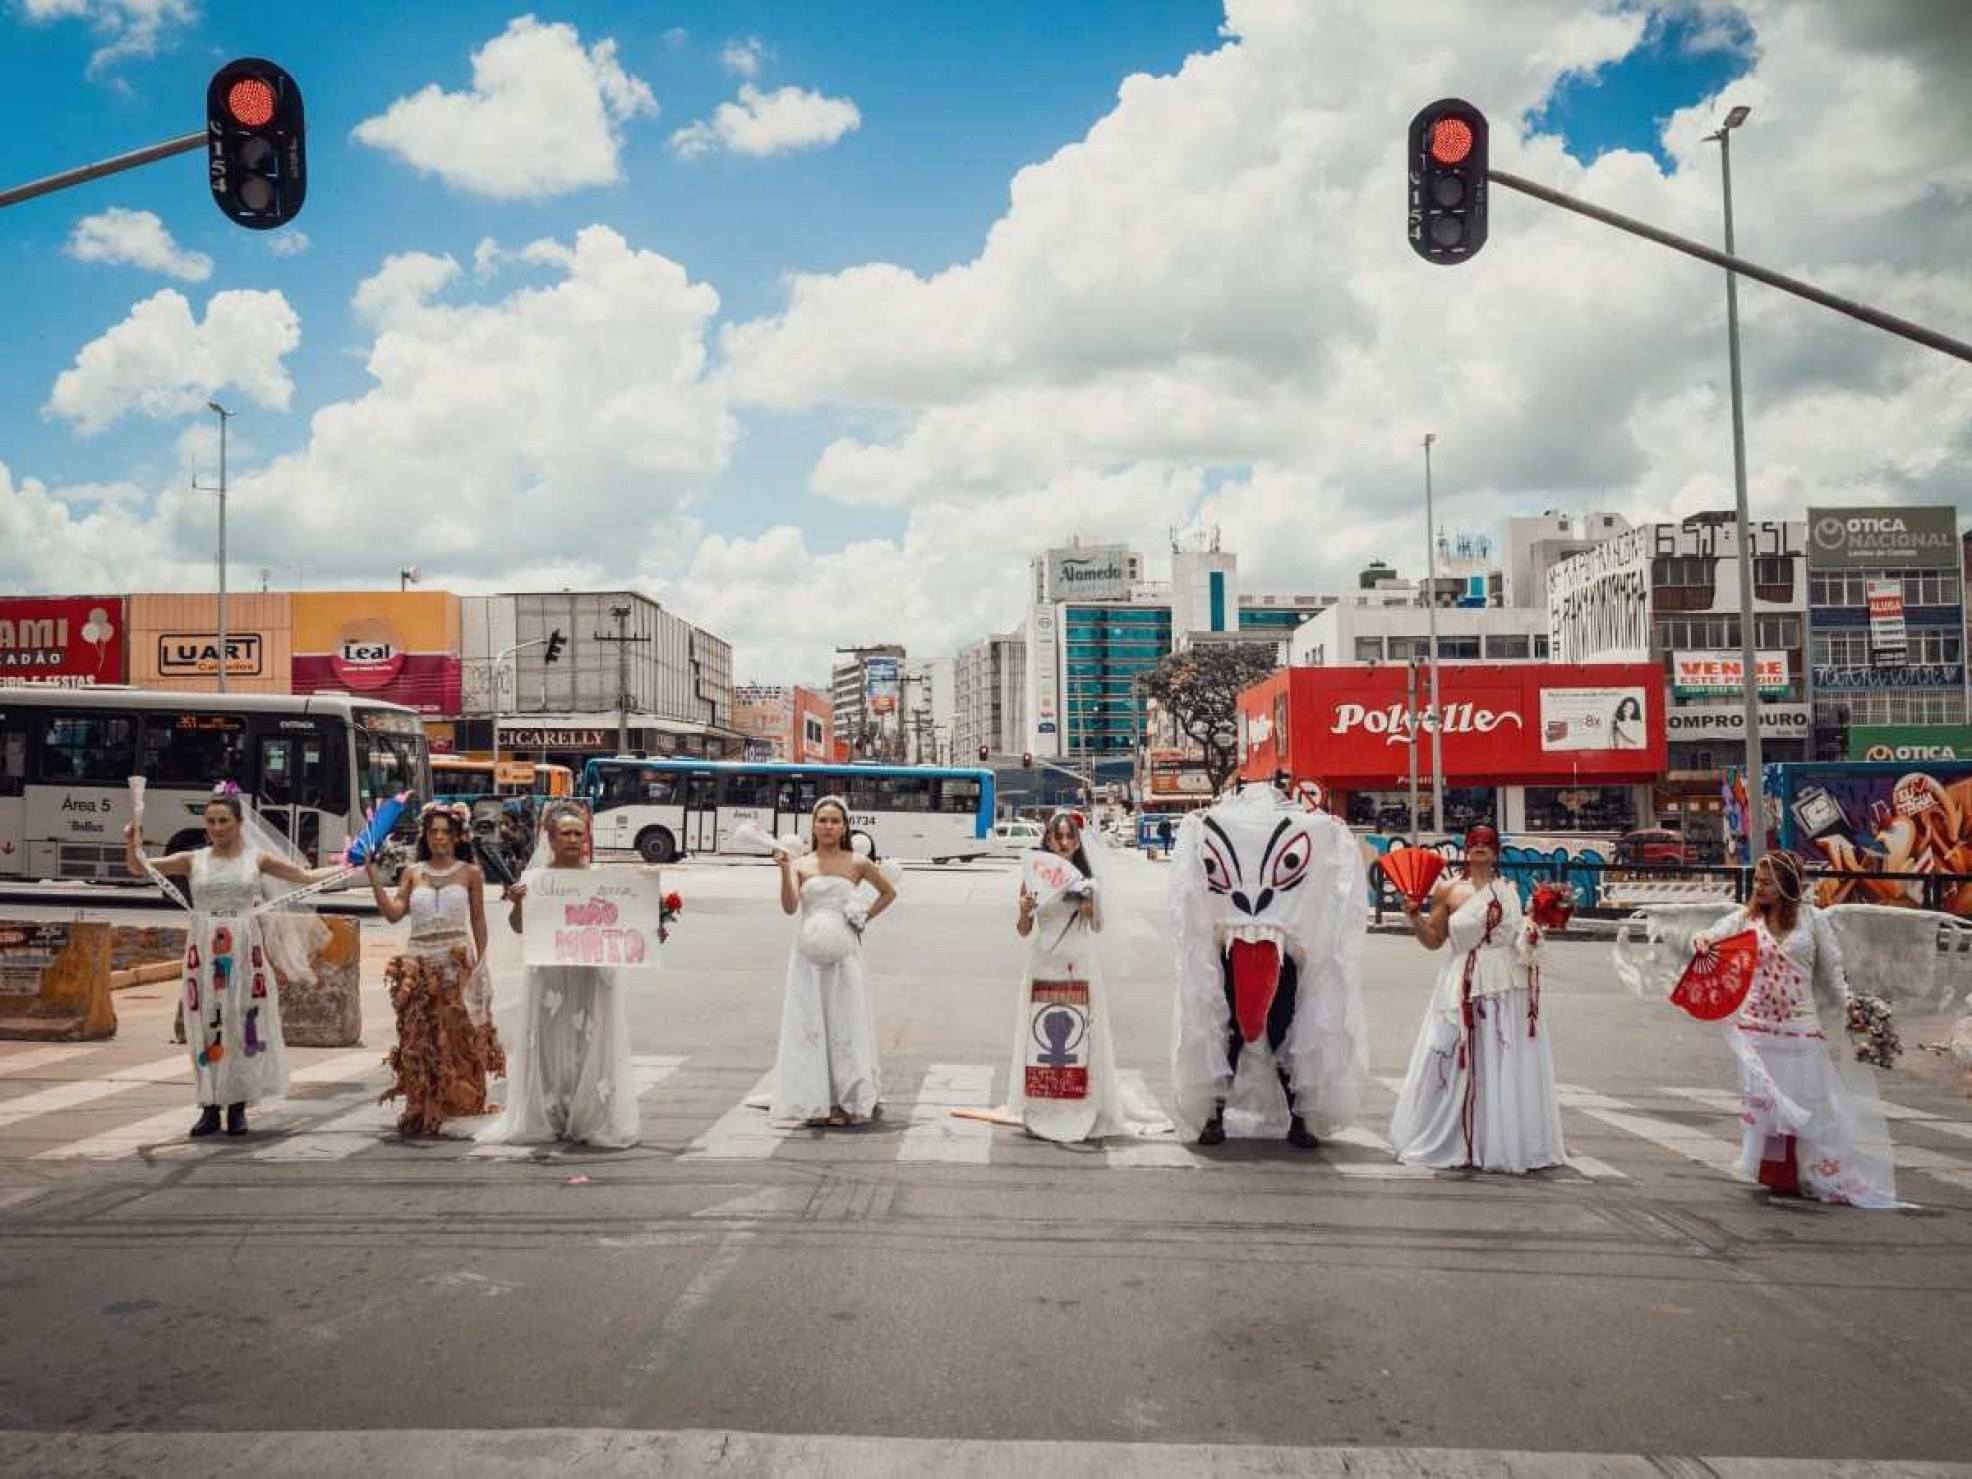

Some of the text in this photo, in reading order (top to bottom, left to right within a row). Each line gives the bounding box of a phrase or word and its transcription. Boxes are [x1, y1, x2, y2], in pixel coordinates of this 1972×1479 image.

[1847, 518, 1907, 532] OTICA
[1847, 532, 1952, 548] NACIONAL
[1059, 562, 1122, 581] Alameda
[0, 651, 61, 665] ADÃO
[344, 643, 390, 660] Leal
[1725, 676, 1782, 684] PRDIO
[1668, 714, 1743, 729] OMPRO
[498, 730, 605, 745] CICARELLY
[1896, 745, 1956, 760] OTICA
[61, 792, 111, 812] Área 5
[564, 896, 618, 925] NÃO
